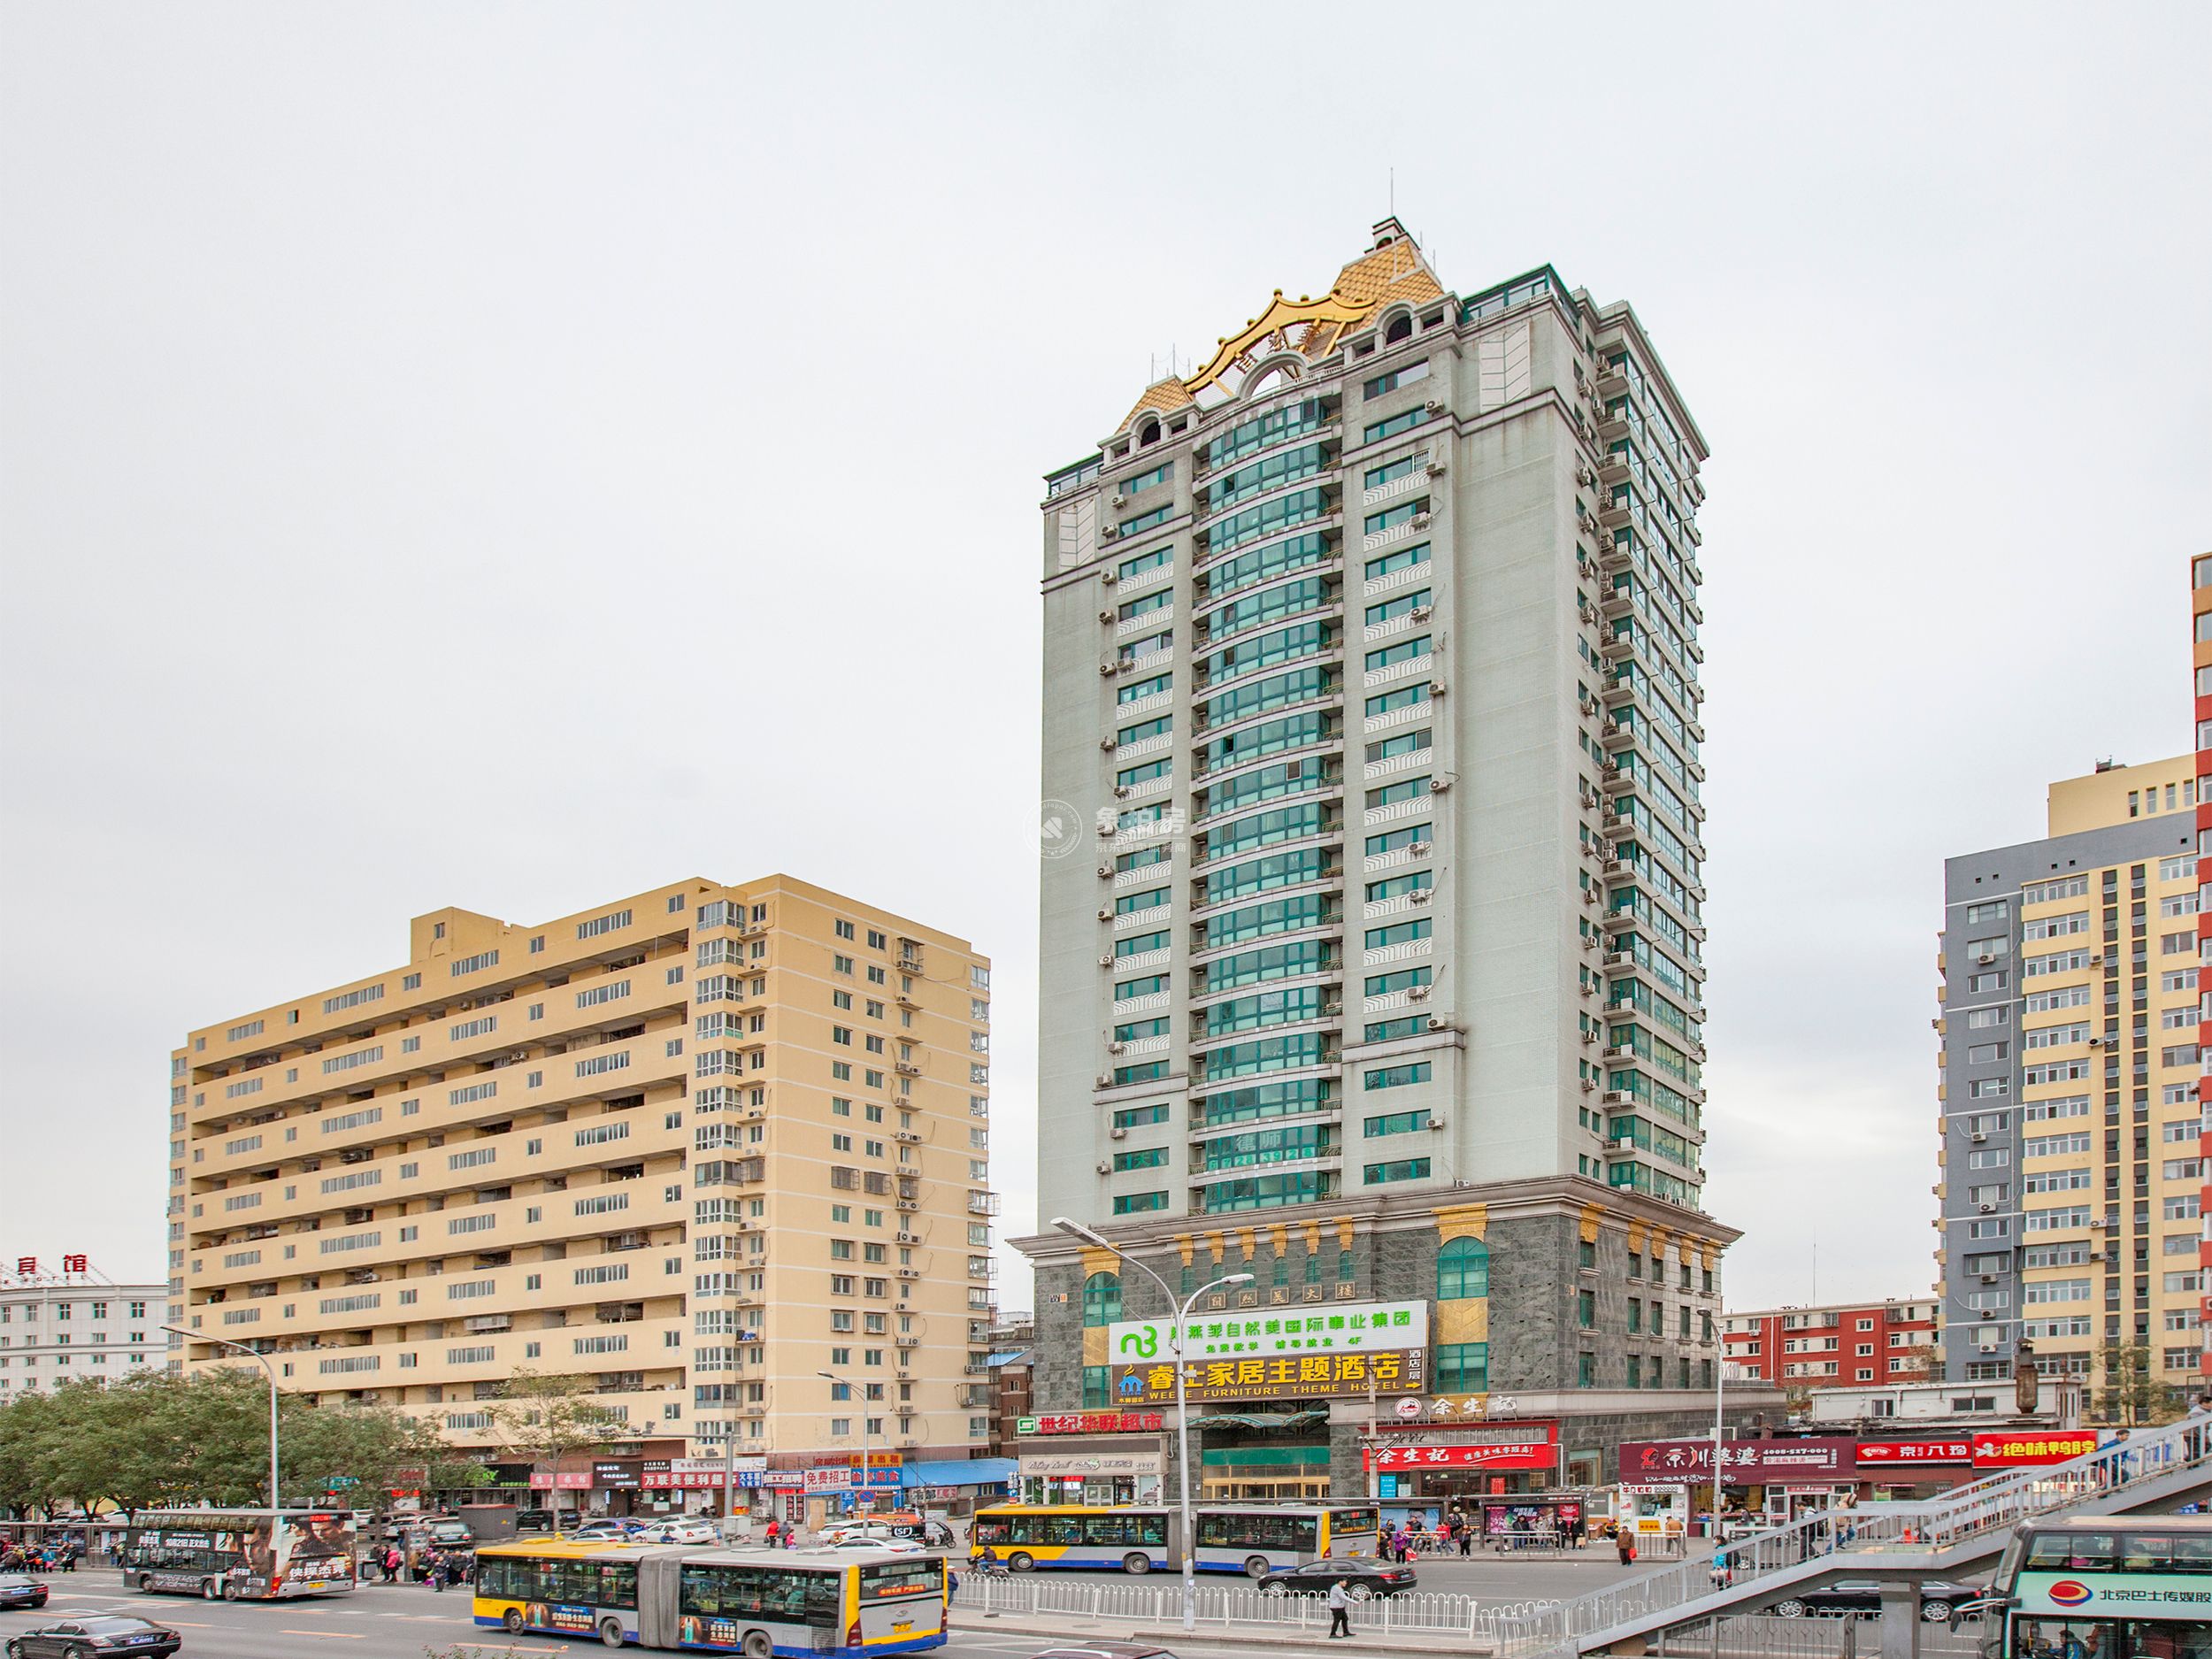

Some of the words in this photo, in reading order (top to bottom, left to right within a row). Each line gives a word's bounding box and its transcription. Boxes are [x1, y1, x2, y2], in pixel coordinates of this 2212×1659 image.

[17, 1254, 87, 1275] 宾馆
[1149, 1390, 1193, 1400] WEEE
[1203, 1386, 1280, 1398] FURNITURE
[1292, 1384, 1340, 1394] THEME
[1350, 1381, 1400, 1391] HOTEL
[1039, 1413, 1163, 1434] 世纪华联超市
[2002, 1440, 2096, 1457] 绝味鸭脖
[806, 1470, 849, 1486] 免费招工
[2100, 1589, 2211, 1603] 北京巴士传媒股
